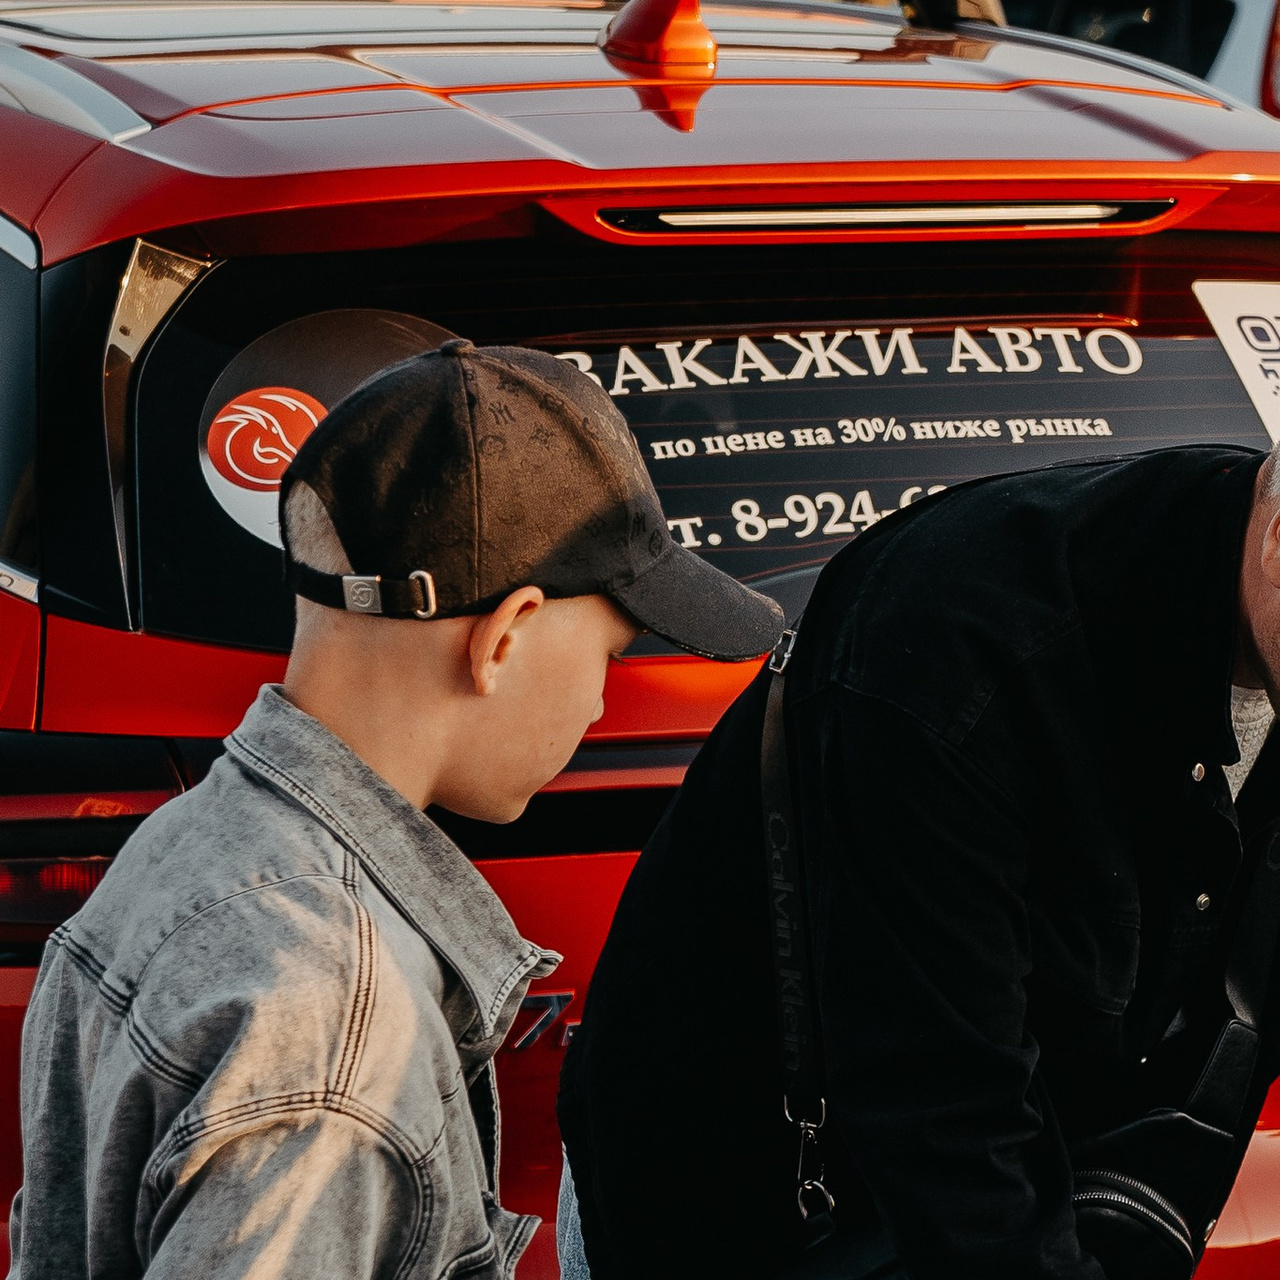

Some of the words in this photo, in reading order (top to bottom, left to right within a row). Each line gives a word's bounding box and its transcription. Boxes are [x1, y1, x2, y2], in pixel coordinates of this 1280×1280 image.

[946, 326, 1143, 376] АВТО
[650, 438, 696, 459] по
[702, 429, 785, 456] цене
[790, 426, 835, 447] на
[838, 417, 907, 449] 30%
[910, 419, 1002, 440] ниже
[1005, 418, 1113, 444] рынка
[767, 811, 797, 957] Calvin
[779, 969, 808, 1071] Klein
